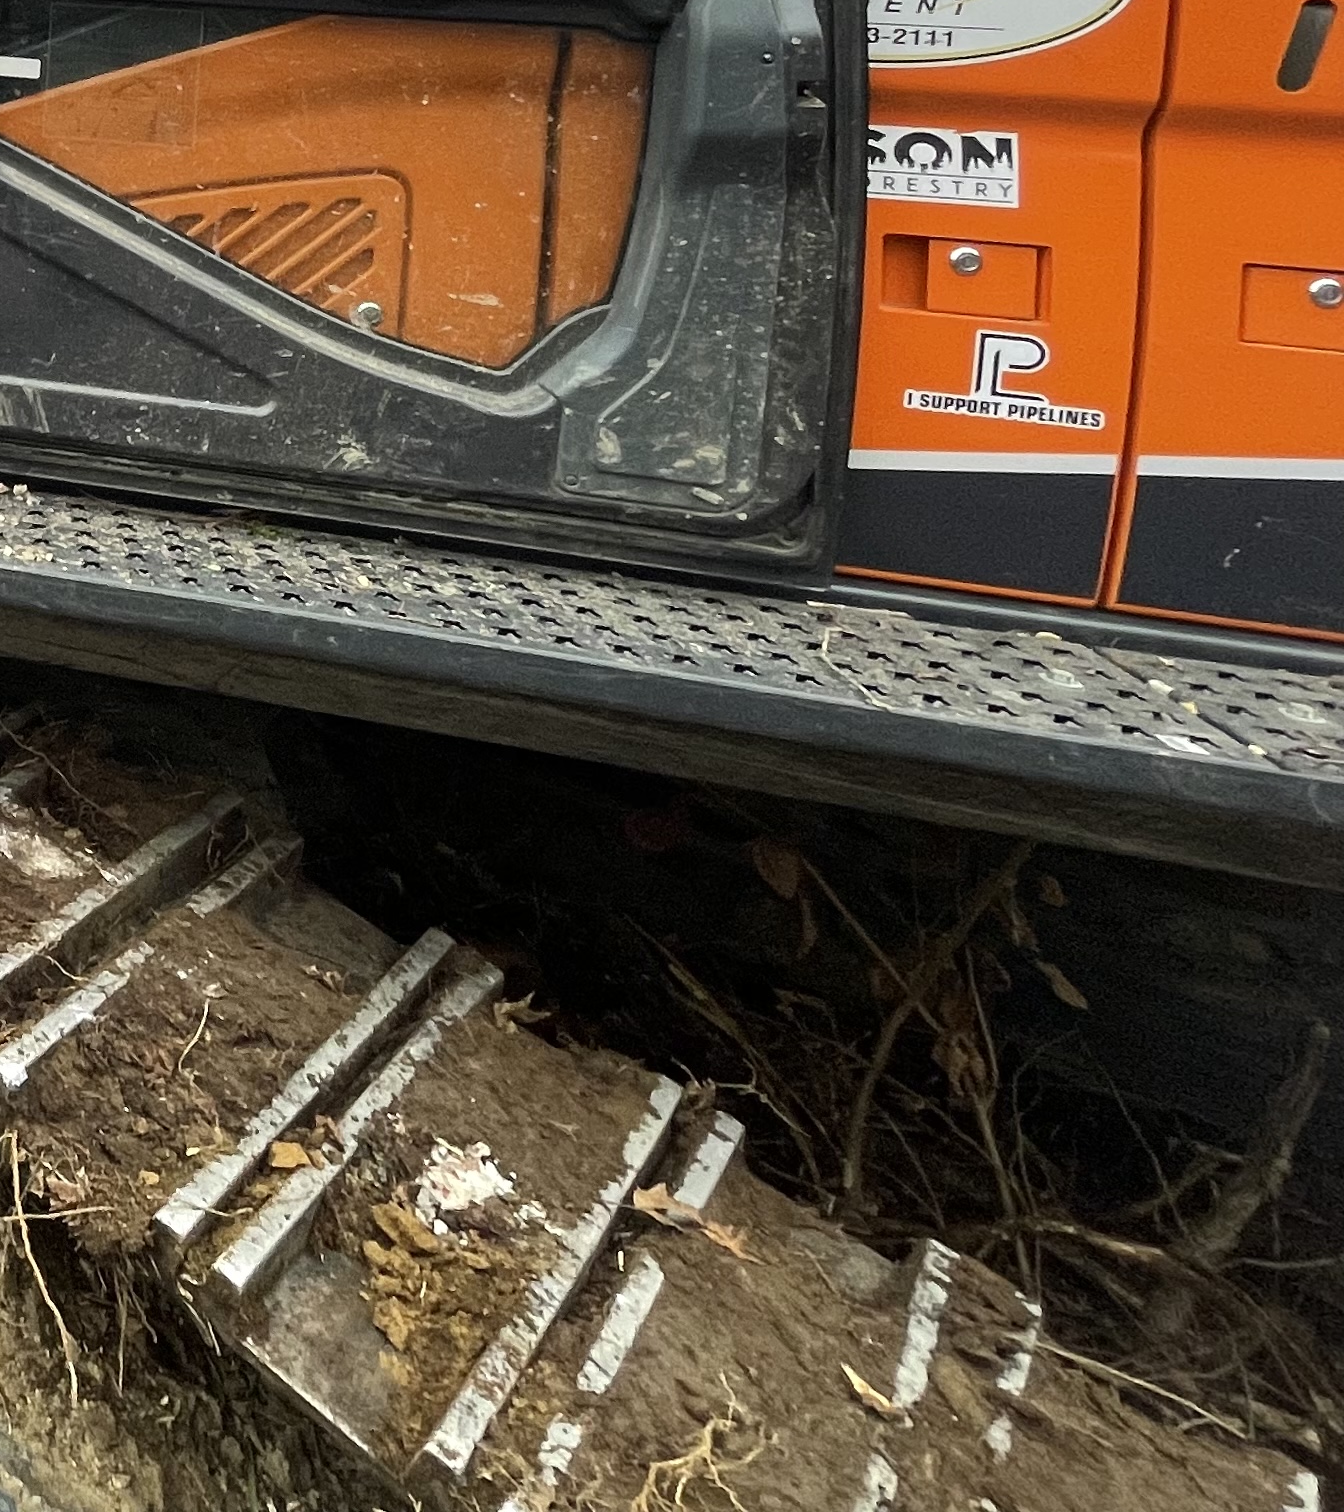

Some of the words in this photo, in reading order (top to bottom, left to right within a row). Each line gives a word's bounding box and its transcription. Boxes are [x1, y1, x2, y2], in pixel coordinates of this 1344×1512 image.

[867, 175, 1013, 198] RESTRY
[907, 392, 913, 406] I
[919, 393, 1001, 416] SUPPORT
[1008, 403, 1102, 428] PIPELINES
